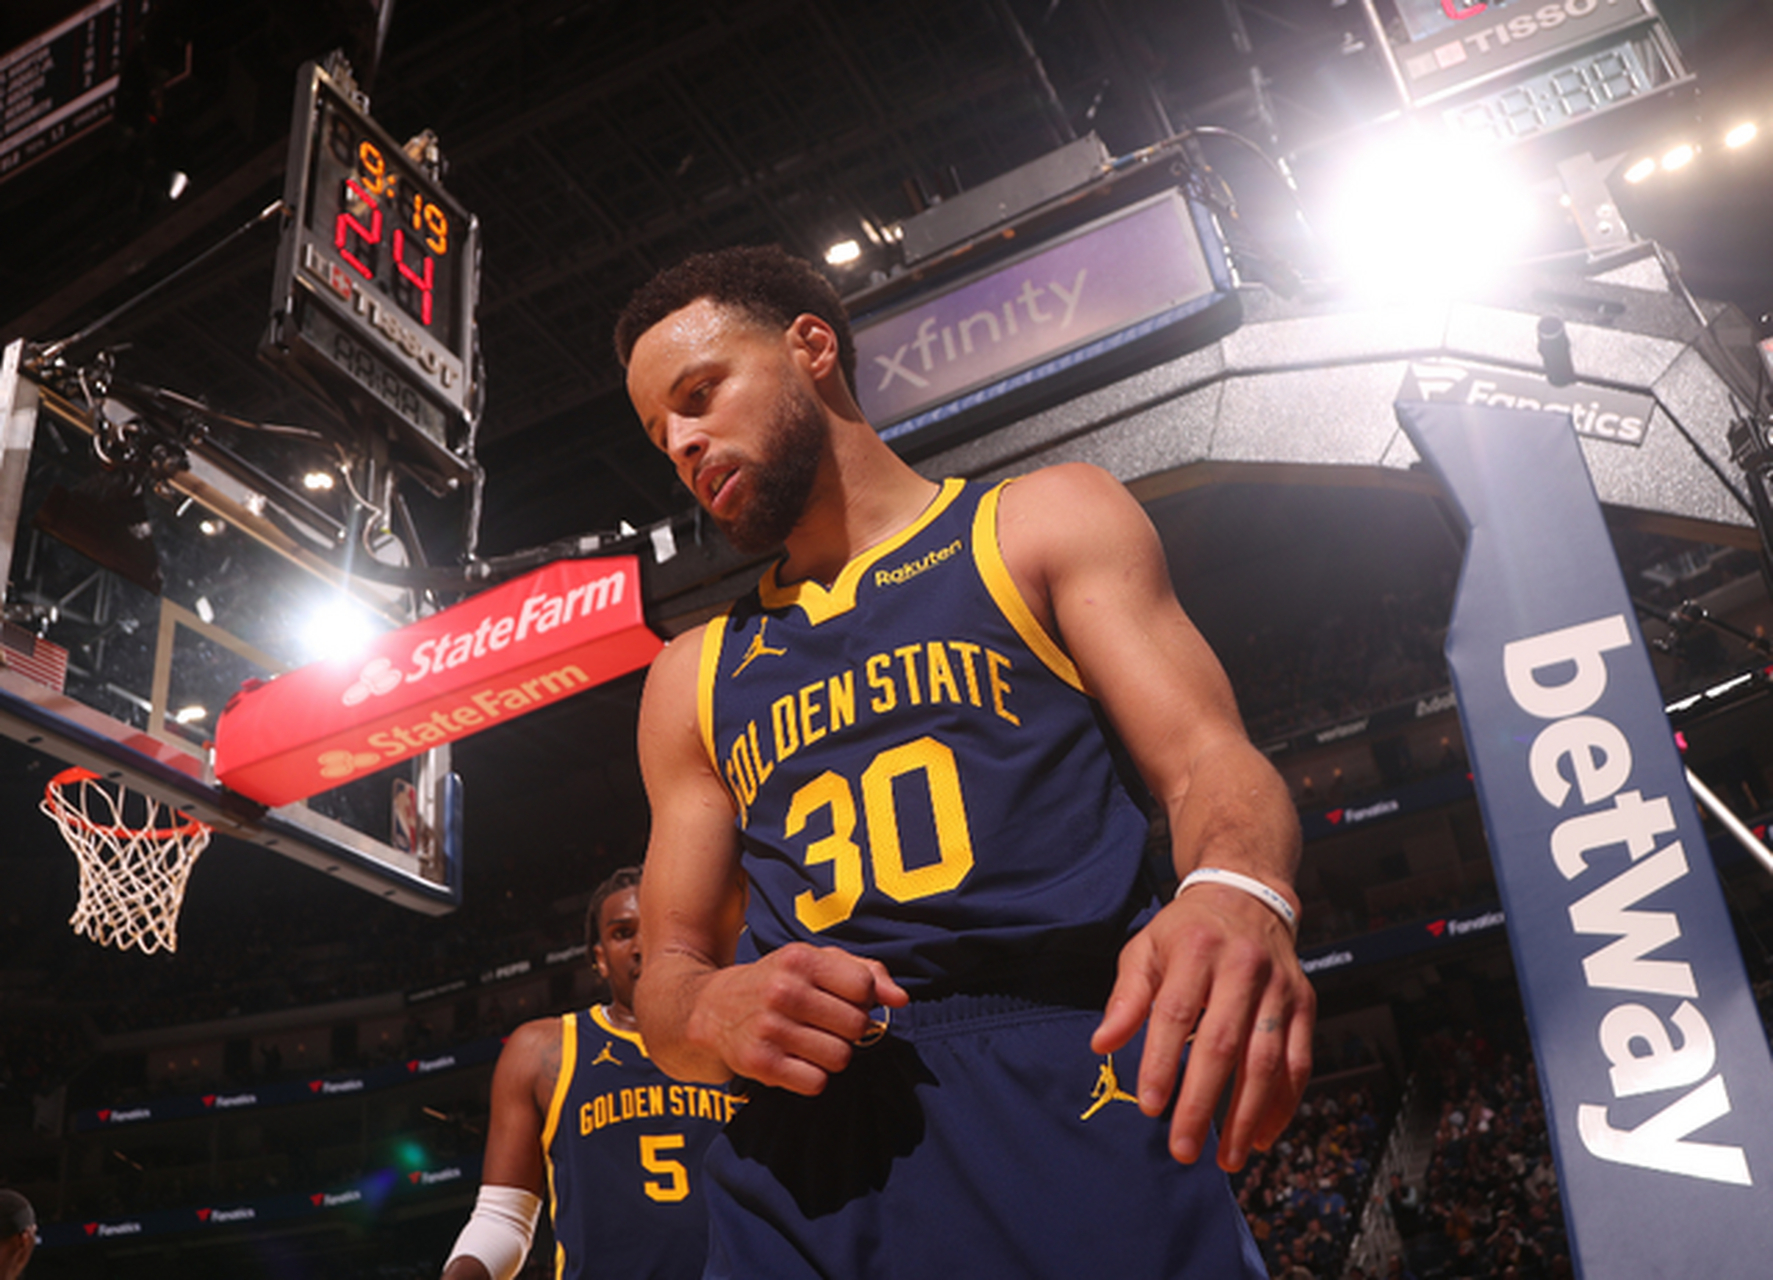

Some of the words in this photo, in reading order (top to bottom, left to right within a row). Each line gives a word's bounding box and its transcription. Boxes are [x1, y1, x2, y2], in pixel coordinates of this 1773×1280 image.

[1464, 0, 1618, 53] TISSO
[359, 140, 448, 255] 9:19
[334, 178, 434, 325] 24
[351, 283, 460, 391] TISSOT
[873, 267, 1088, 392] xfinity
[873, 538, 963, 588] Rakuten
[865, 640, 1021, 727] STATE
[783, 735, 976, 933] 30
[1345, 800, 1399, 822] Fanatics
[1503, 613, 1754, 1187] betway
[323, 1078, 363, 1093] Fanatics
[418, 1054, 455, 1072] Fanatics
[111, 1107, 150, 1122] Fanatics
[216, 1094, 256, 1109] Fanatics
[580, 1085, 664, 1136] GOLDEN
[421, 1166, 461, 1185] Fanatics
[639, 1133, 690, 1202] 5
[211, 1207, 255, 1222] Fanatics
[324, 1189, 361, 1206] Fanatics
[98, 1221, 141, 1237] Fanatics
